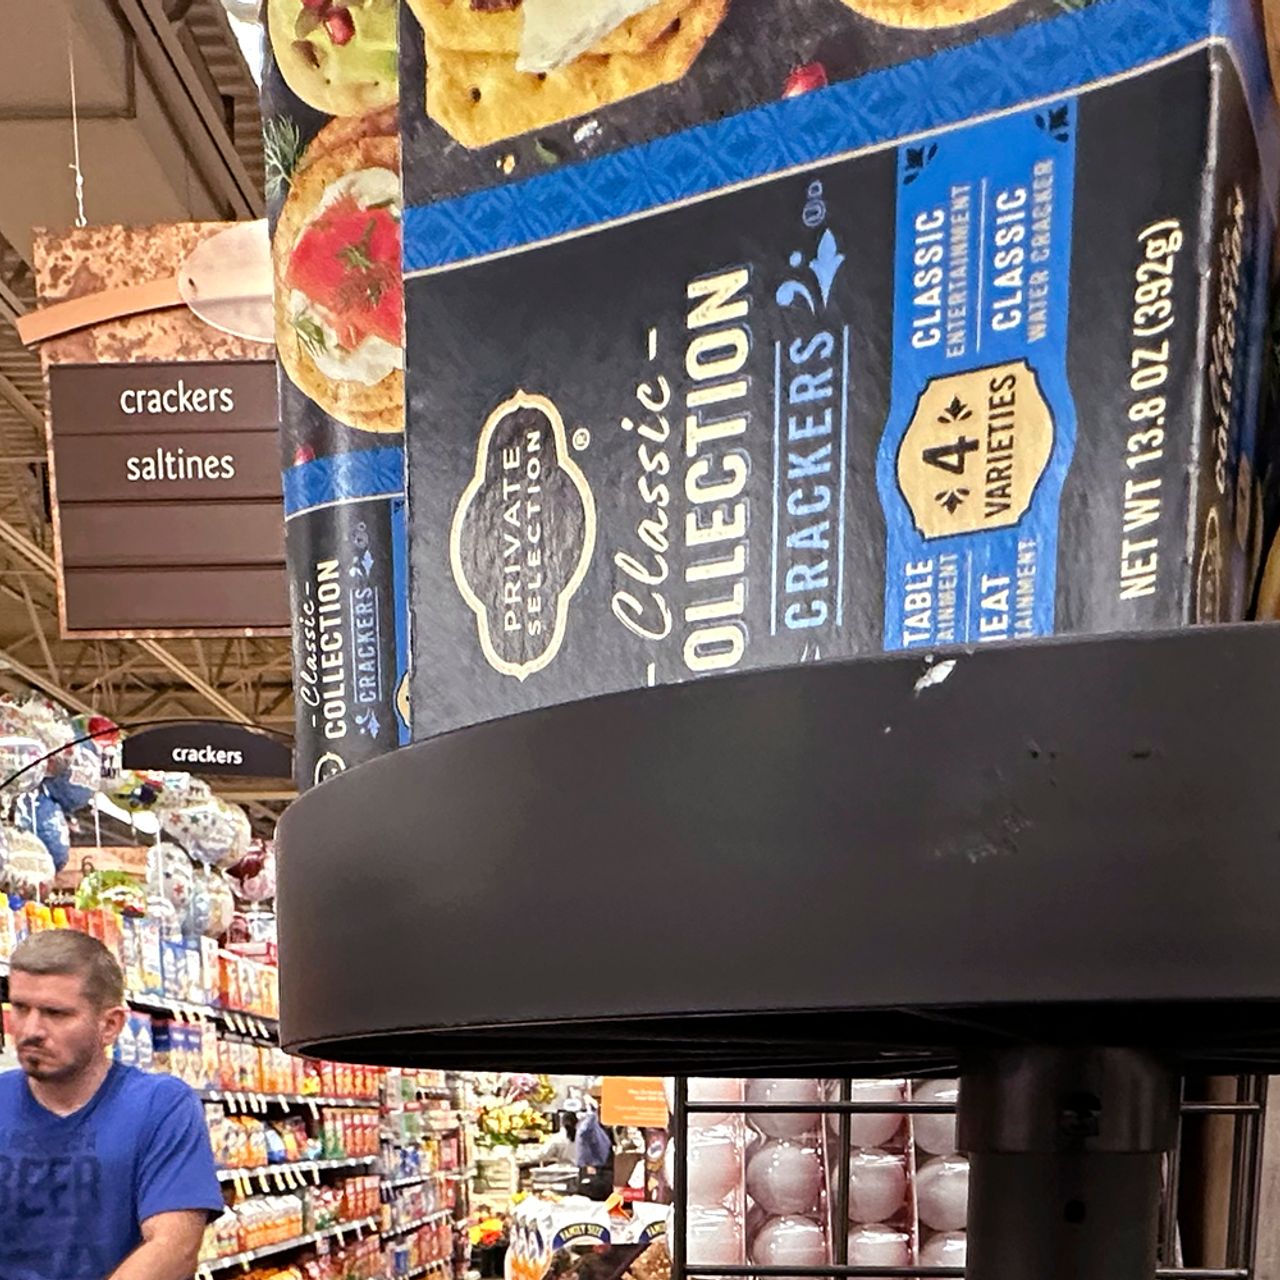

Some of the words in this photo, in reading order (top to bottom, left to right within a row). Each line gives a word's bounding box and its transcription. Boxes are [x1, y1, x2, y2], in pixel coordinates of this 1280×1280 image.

[912, 209, 946, 351] CLASSIC
[946, 183, 972, 360] ENTERTAINMENT
[992, 187, 1028, 332] CLASSIC
[1133, 217, 1182, 338] (392g)
[120, 379, 235, 415] crackers
[1131, 338, 1170, 386] OZ
[126, 445, 236, 482] saltines
[682, 266, 751, 673] OLLECTION
[783, 330, 836, 631] CRACKERS
[922, 434, 981, 478] 4
[984, 373, 1018, 521] VARIETIES
[1127, 395, 1167, 468] 13.8
[502, 445, 523, 633] PRIVATE
[526, 430, 544, 638] SELECTION
[611, 374, 672, 642] Classic
[1120, 533, 1159, 600] NET
[1123, 478, 1162, 532] WT
[317, 559, 348, 741] COLLECTION
[355, 587, 378, 703] CRACKERS
[172, 745, 244, 766] crackers
